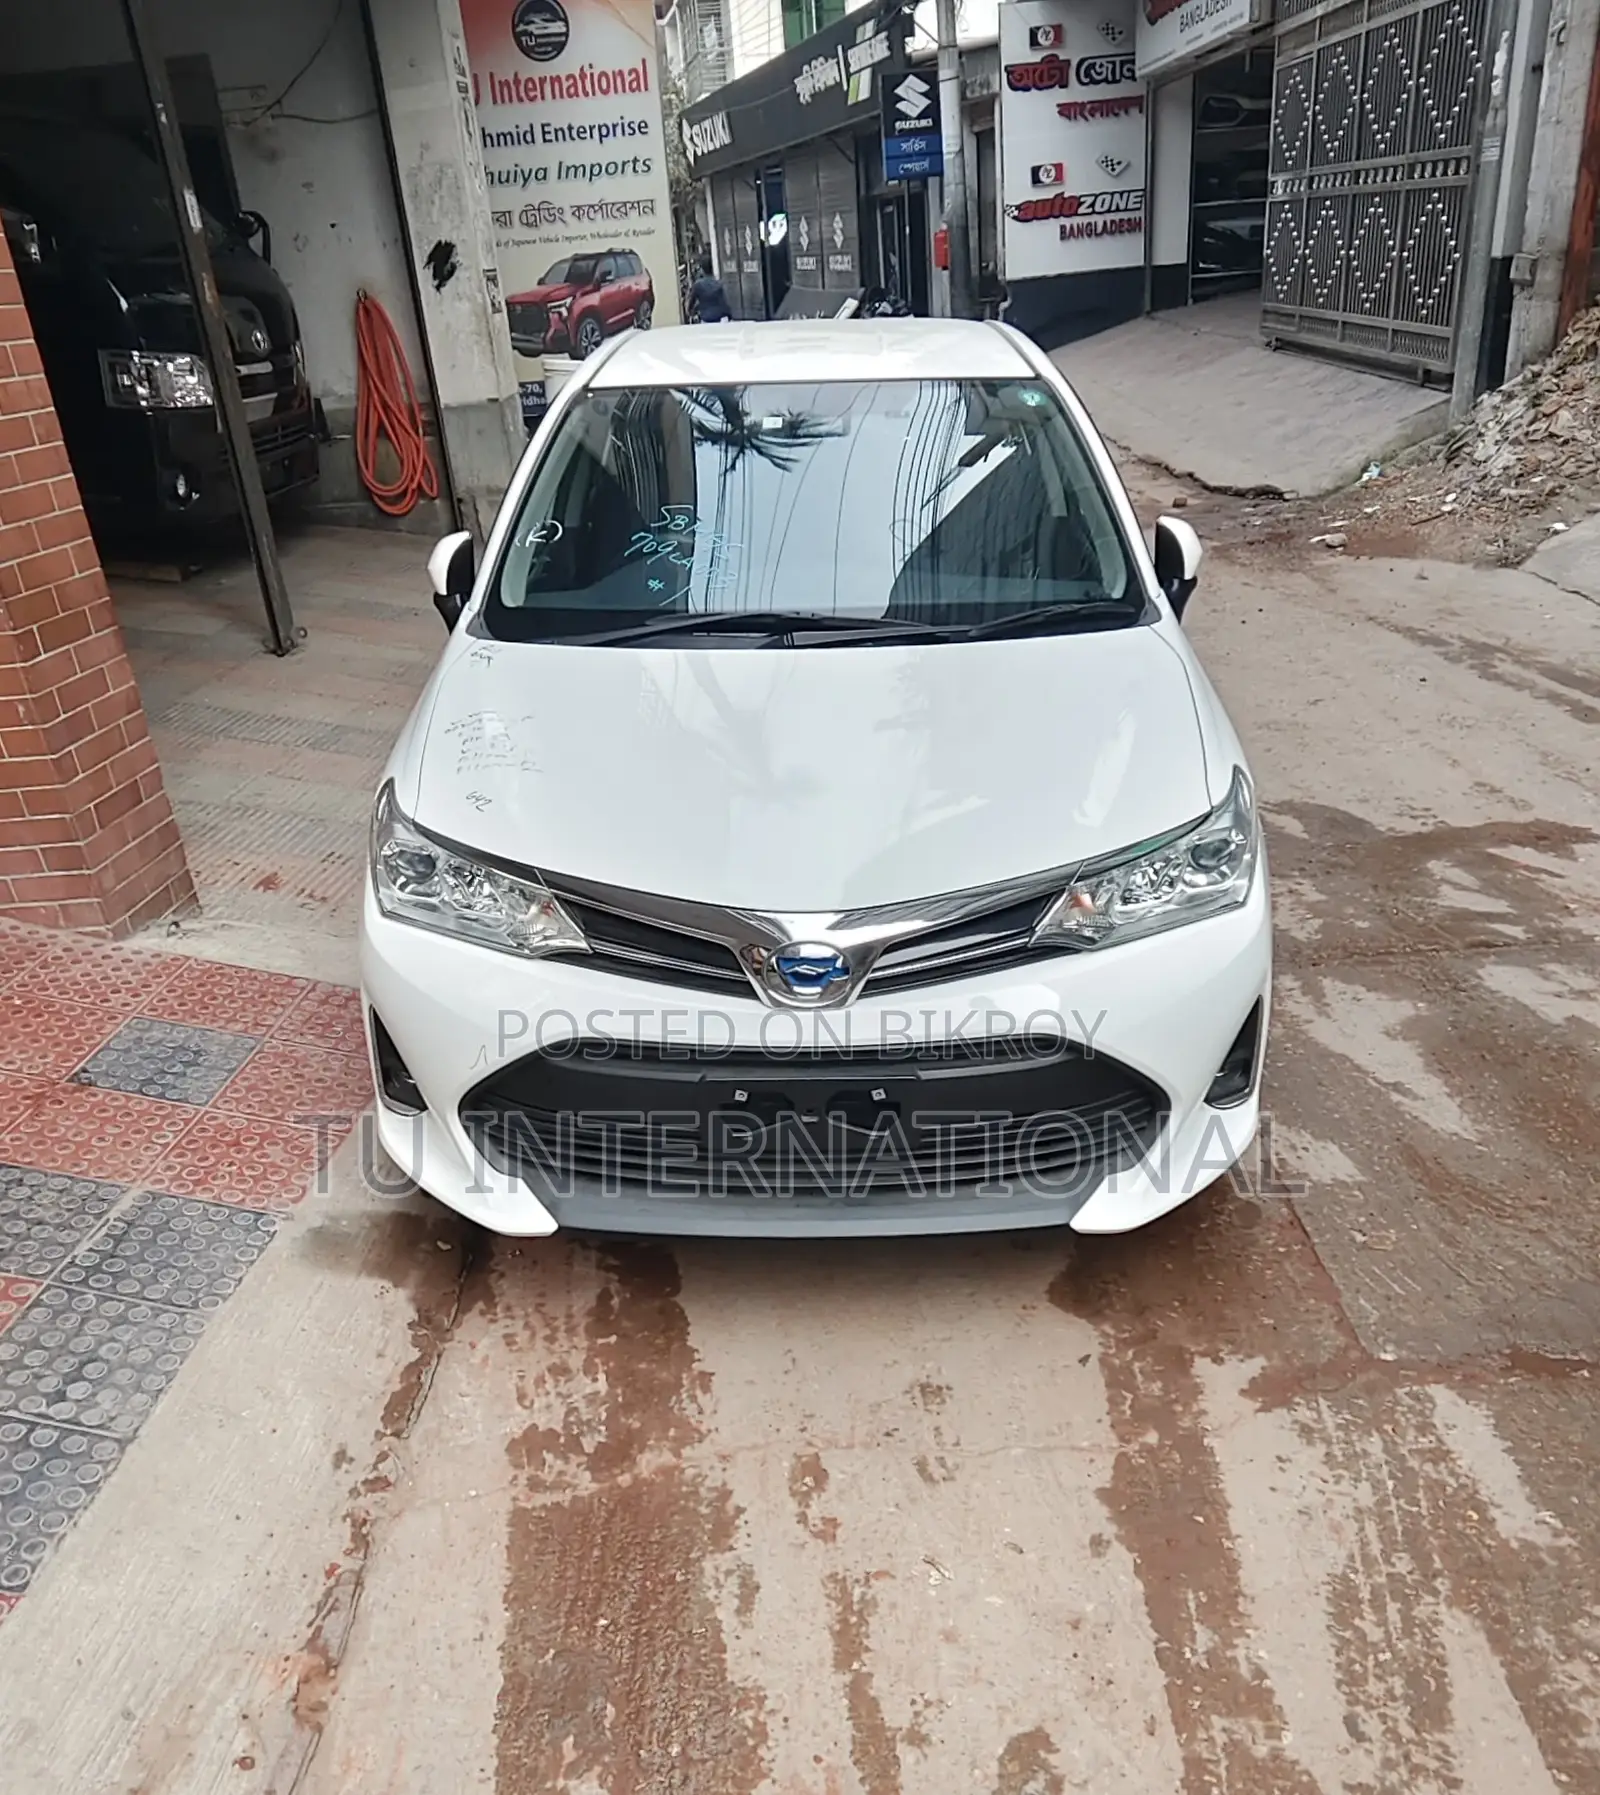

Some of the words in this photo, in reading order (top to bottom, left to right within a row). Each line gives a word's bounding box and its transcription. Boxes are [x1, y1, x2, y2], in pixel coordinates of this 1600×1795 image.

[488, 57, 649, 106] International
[541, 115, 649, 144] Enterprise
[691, 111, 733, 157] SUZUKI
[894, 118, 933, 131] SUZUKI
[557, 156, 652, 182] Imports
[1060, 217, 1142, 241] BANGLADESH
